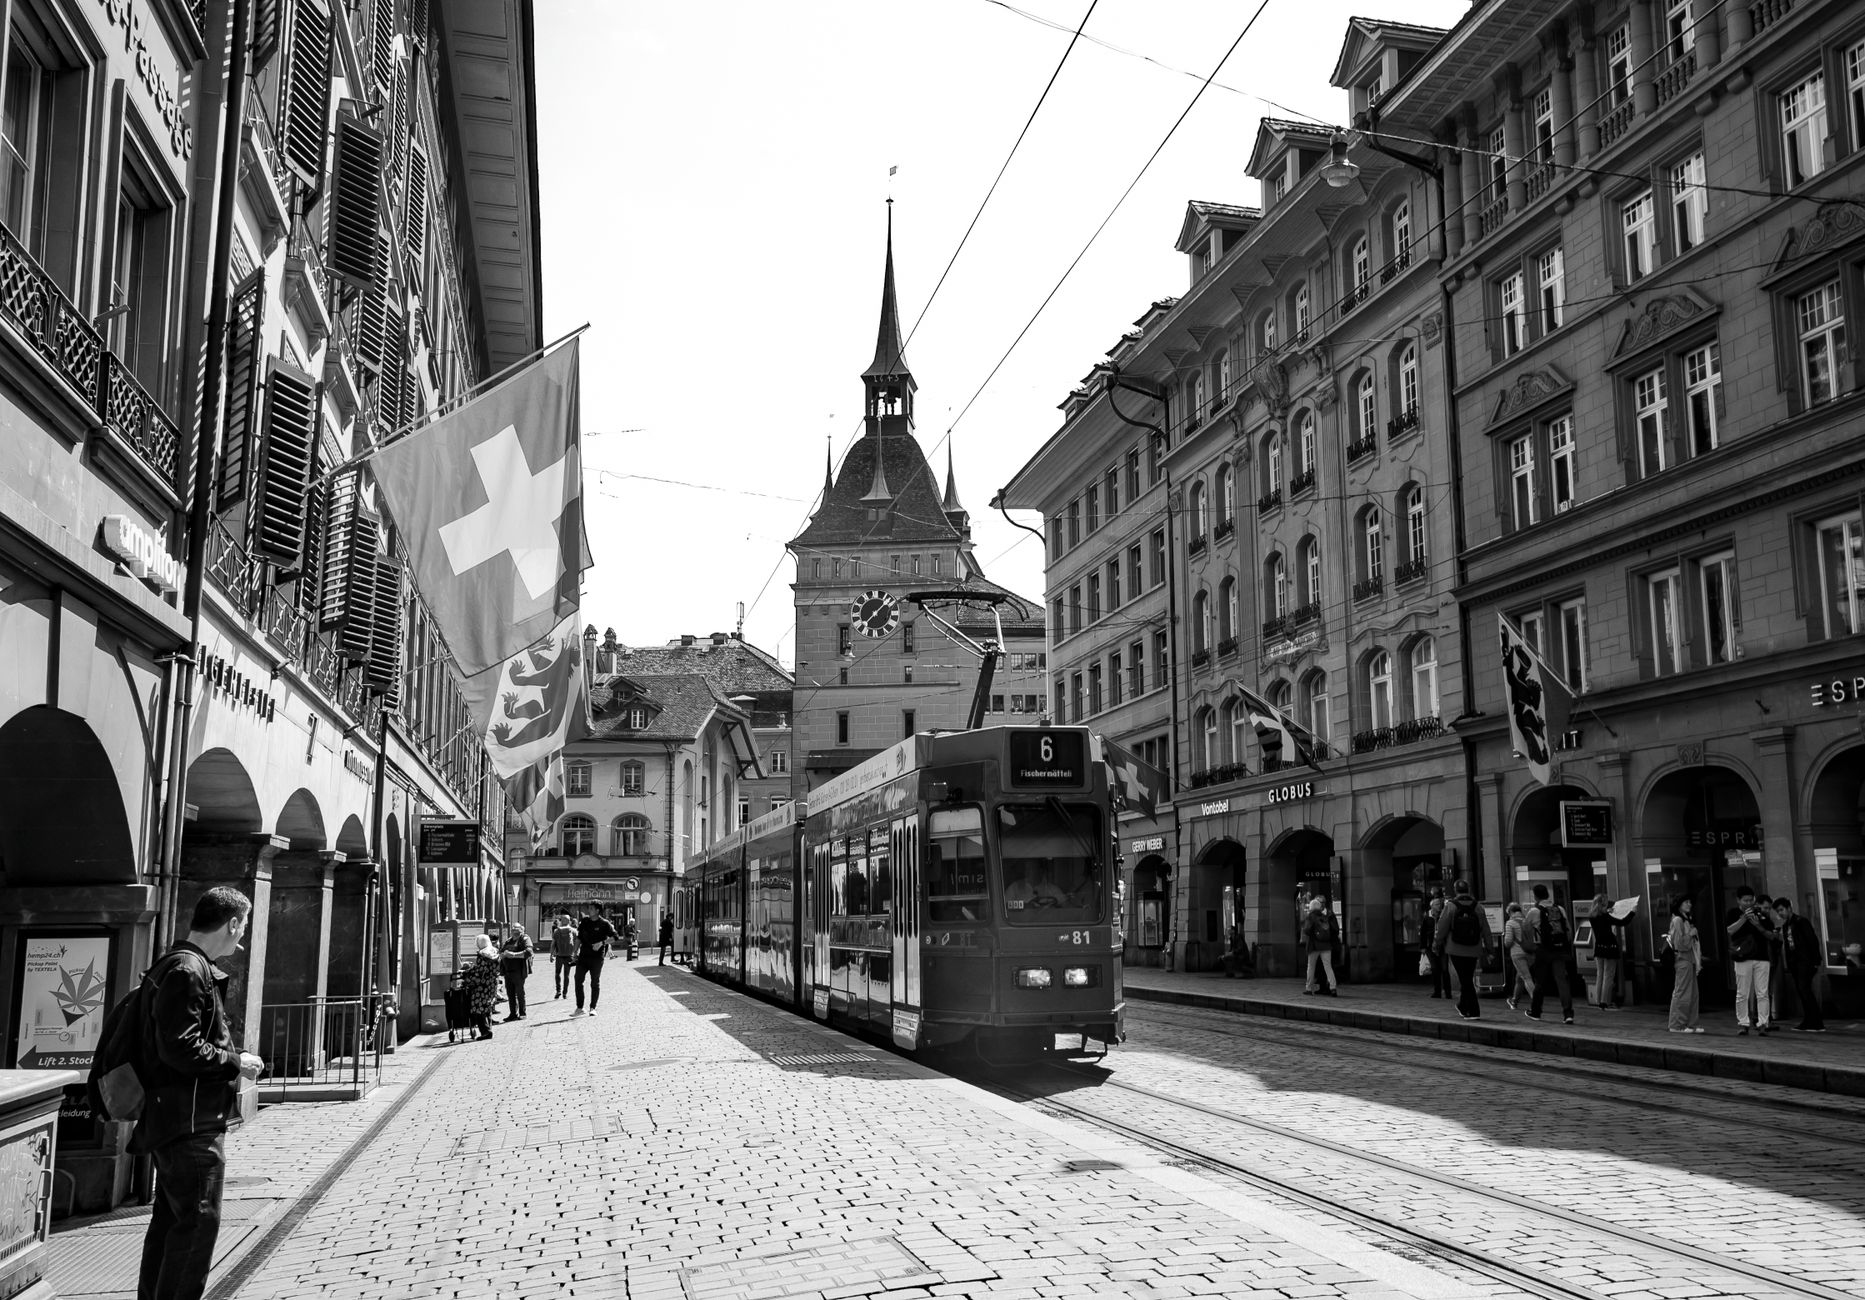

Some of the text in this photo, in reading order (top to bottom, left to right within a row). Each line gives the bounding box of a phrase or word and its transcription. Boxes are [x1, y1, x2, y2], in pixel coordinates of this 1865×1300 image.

[1810, 677, 1865, 707] ESP
[1040, 736, 1053, 762] 6
[1268, 782, 1312, 803] GLOBUS
[1201, 799, 1229, 816] Vontobel
[1132, 838, 1163, 853] GERRY WEBER
[1072, 930, 1090, 945] 81
[27, 952, 61, 961] hemp24.ch
[38, 1057, 57, 1067] Lift
[58, 1057, 67, 1065] 2.
